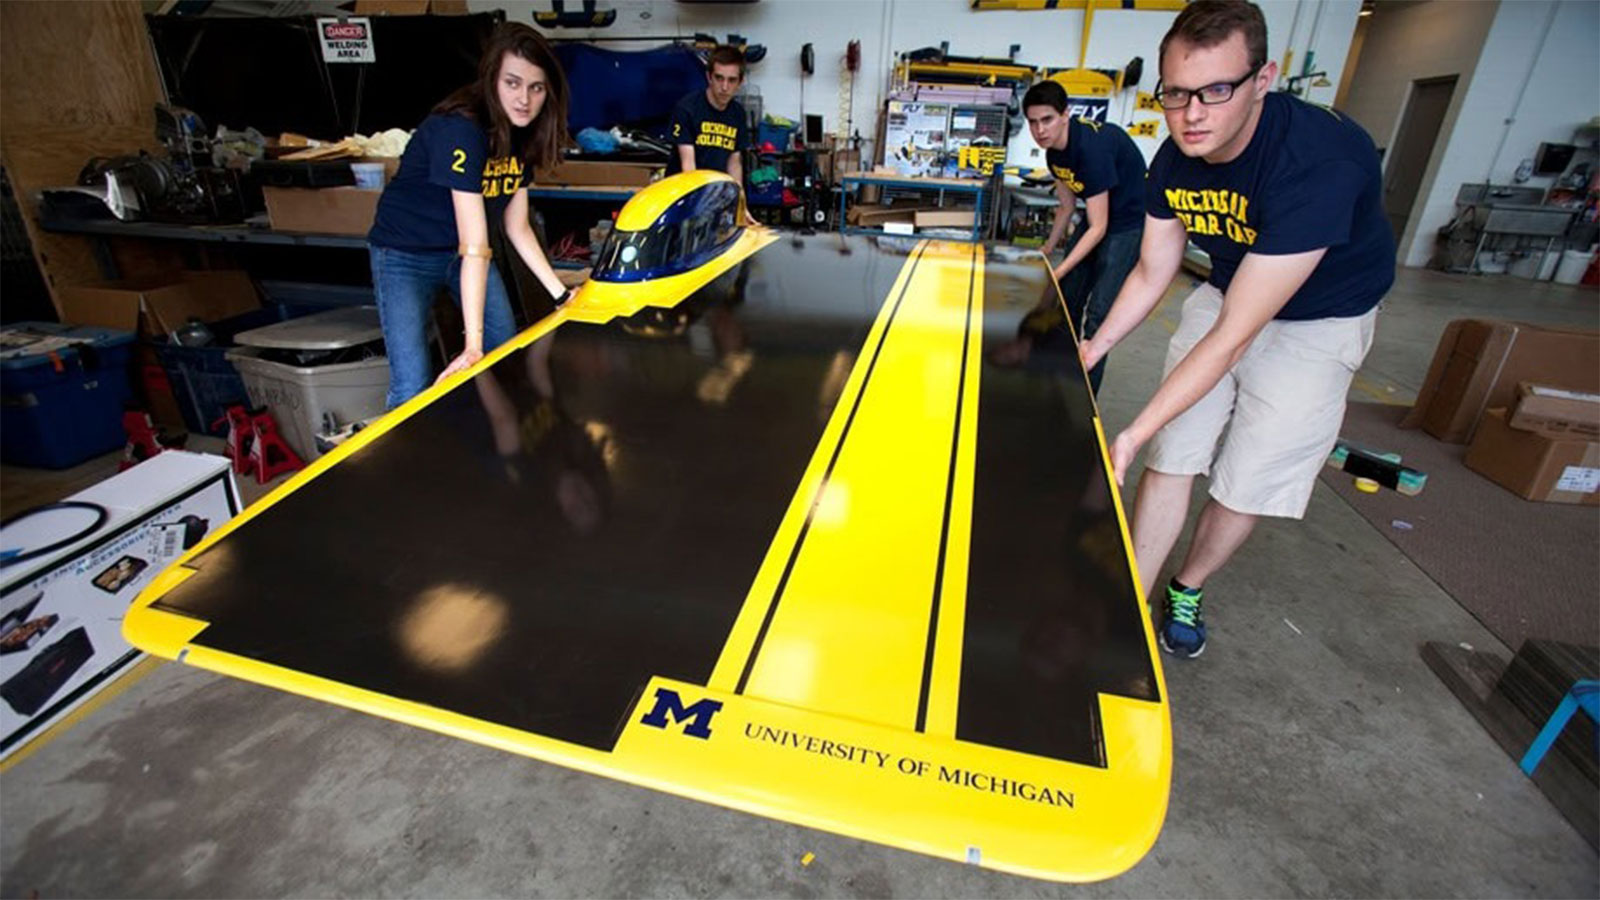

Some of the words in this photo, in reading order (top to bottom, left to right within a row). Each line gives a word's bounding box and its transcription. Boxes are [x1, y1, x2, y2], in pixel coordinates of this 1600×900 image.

[325, 26, 366, 37] DANGER
[327, 41, 368, 49] WELDING
[673, 124, 681, 137] 2
[452, 148, 467, 172] 2
[640, 687, 724, 740] M
[744, 722, 890, 768] UNIVERSITY
[897, 757, 931, 777] OF
[937, 765, 1076, 808] MICHIGAN
